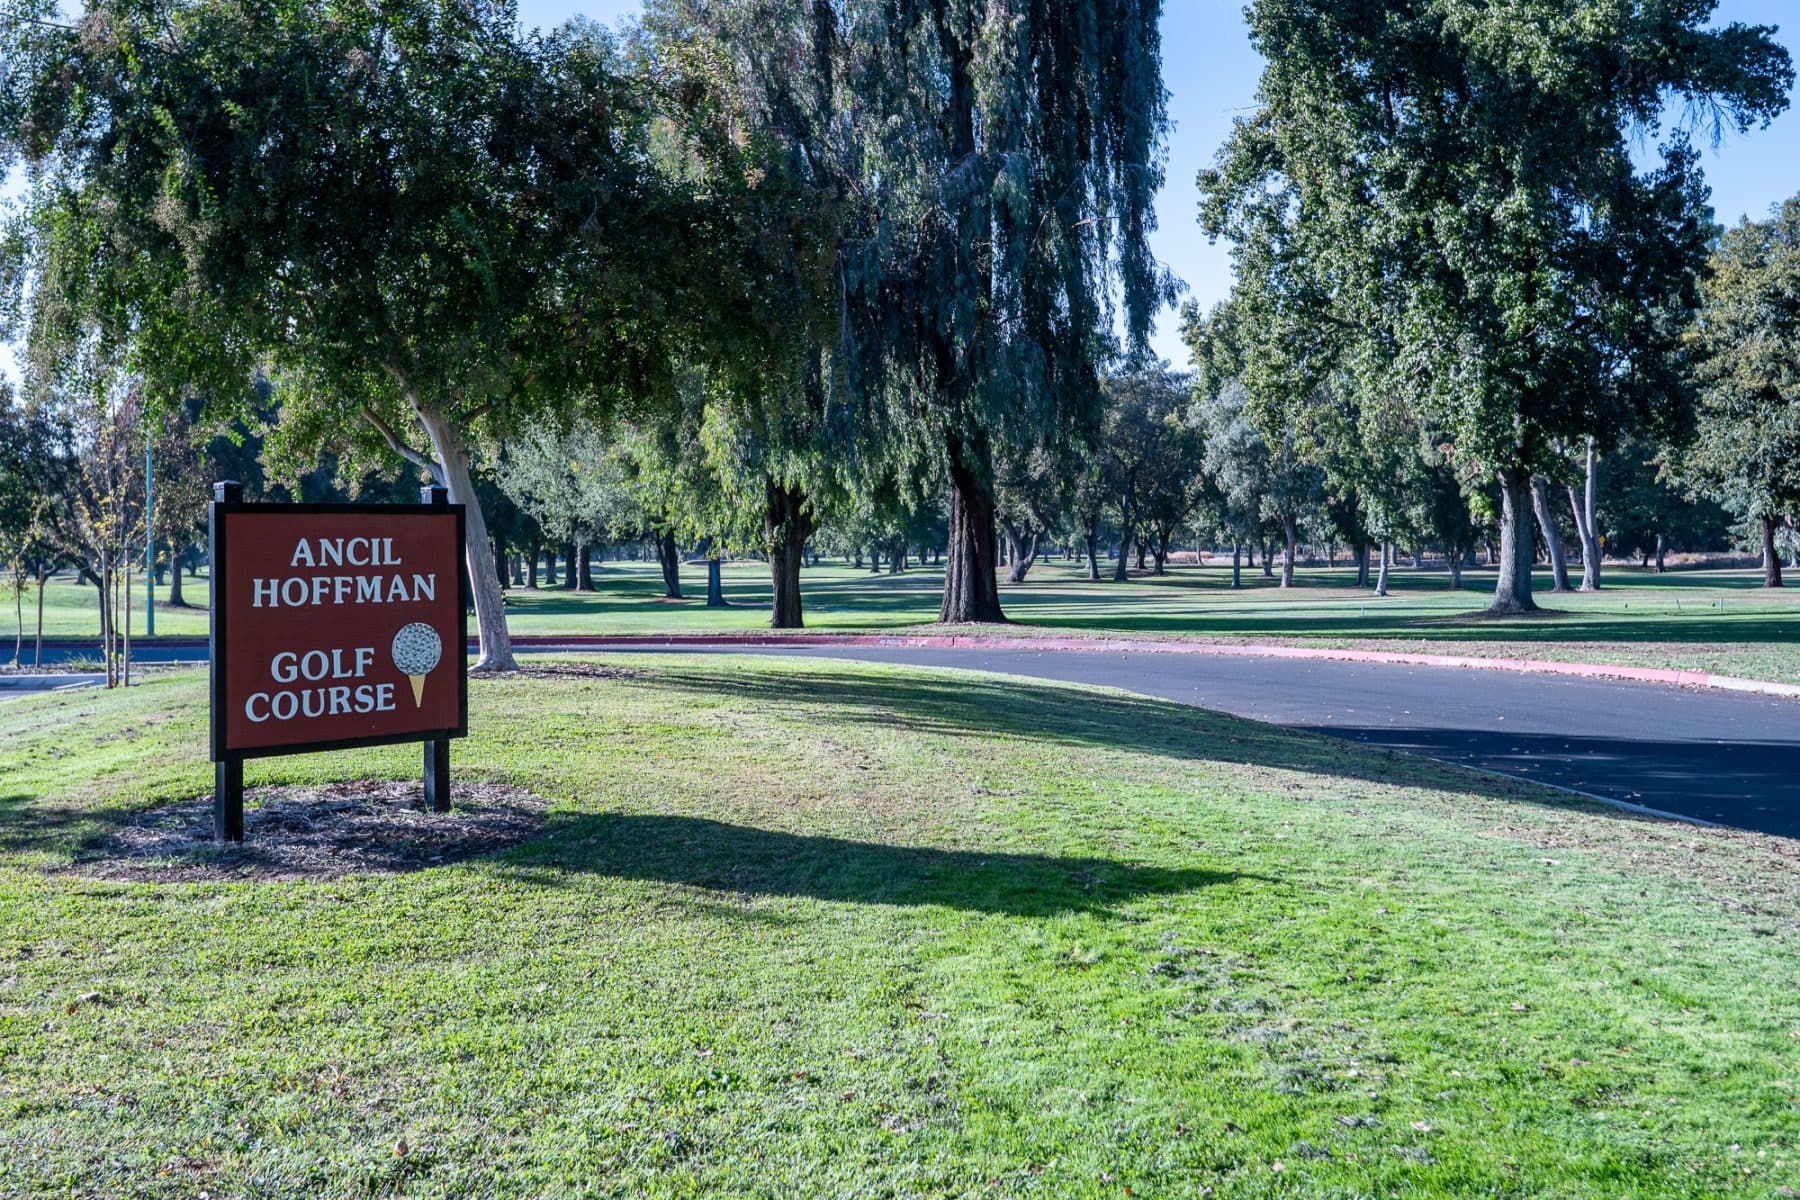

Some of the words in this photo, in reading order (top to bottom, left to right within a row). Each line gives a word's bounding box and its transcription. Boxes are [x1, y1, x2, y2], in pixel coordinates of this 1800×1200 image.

[290, 537, 402, 567] ANCIL
[252, 573, 436, 608] HOFFMAN
[270, 647, 375, 684] GOLF
[245, 683, 397, 722] COURSE
